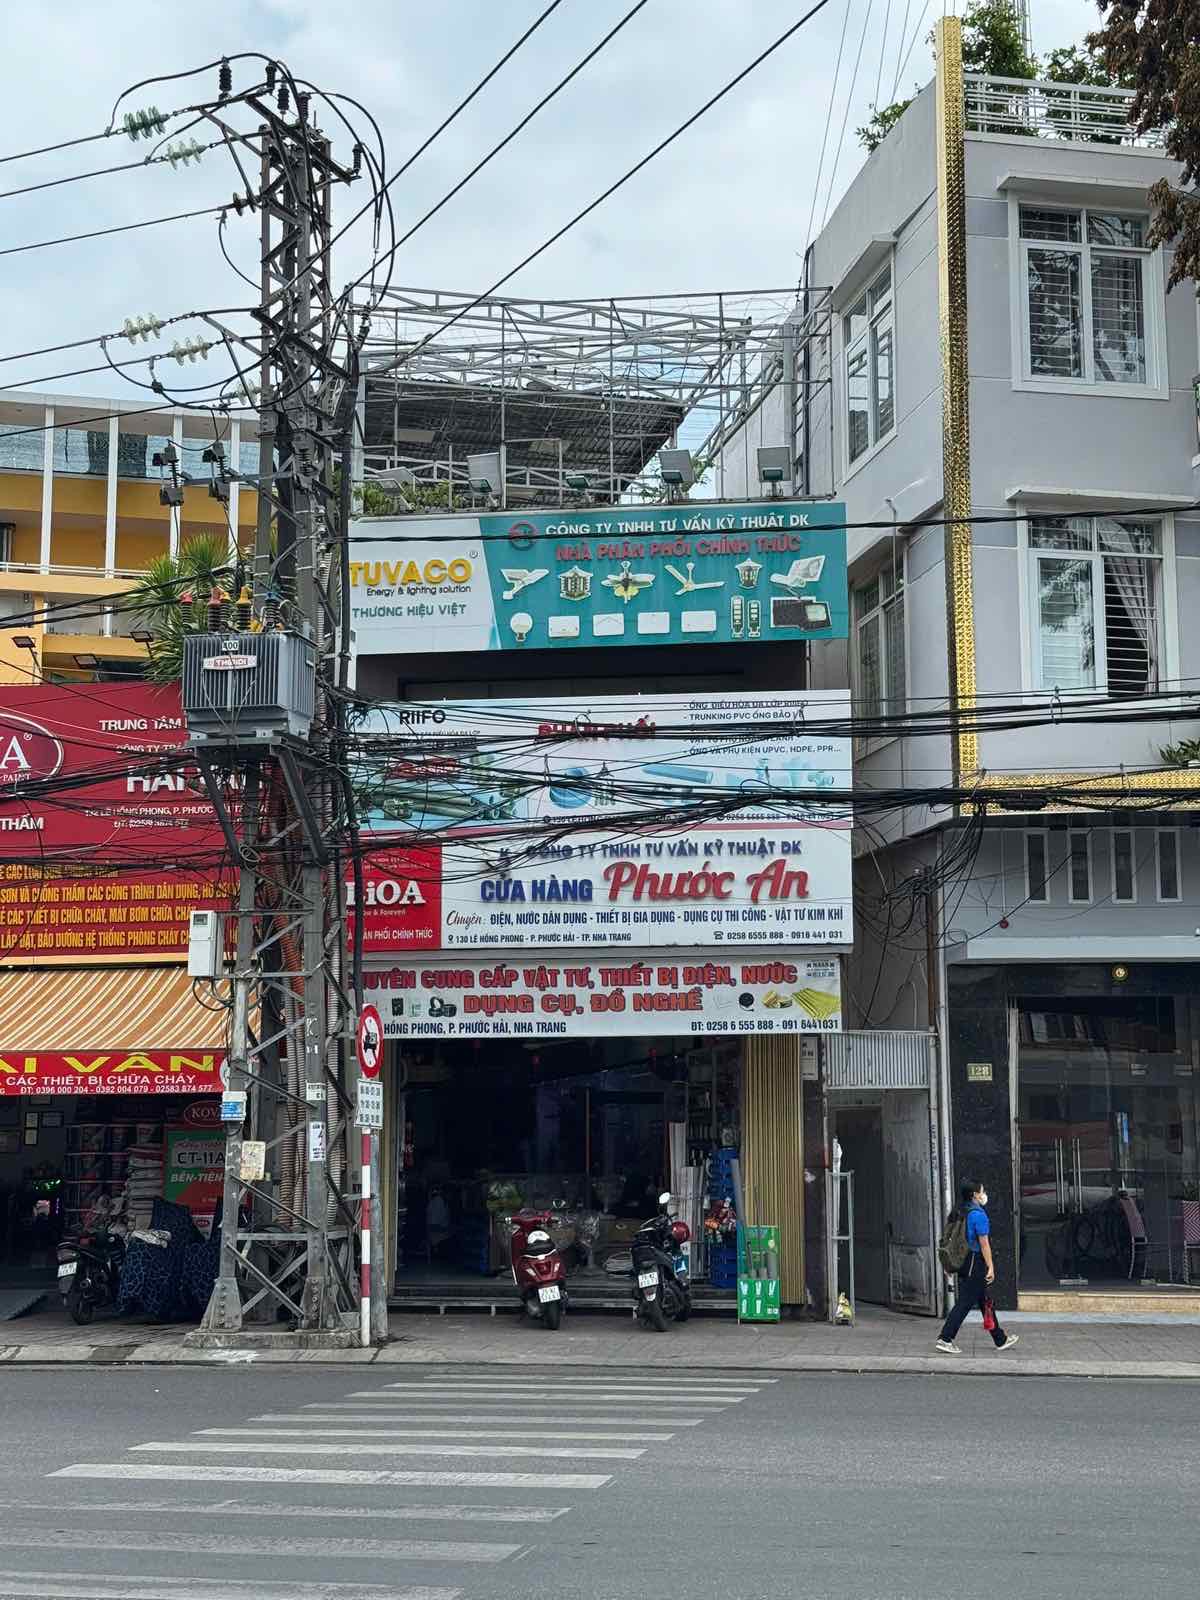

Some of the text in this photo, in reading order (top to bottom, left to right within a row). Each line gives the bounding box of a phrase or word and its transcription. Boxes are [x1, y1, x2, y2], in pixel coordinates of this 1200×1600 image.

[545, 521, 590, 535] CÔNG
[596, 520, 611, 534] TY
[617, 521, 654, 533] TNHH
[660, 518, 677, 531] TƯ
[682, 513, 711, 531] VẤN
[717, 514, 735, 529] KỸ
[741, 512, 785, 529] THUẬT
[555, 533, 801, 560] NHÀ PHÂN PHỐI CHÍNH THỨC
[349, 559, 472, 586] TUVACO
[367, 585, 471, 597] Energy & lighting solution
[352, 603, 466, 618] THƯƠNG HIỆU VIỆT
[99, 715, 182, 731] TRUNG TÂM
[690, 708, 791, 720] TRUNKING PVC ỐNG BẢO
[0, 735, 31, 769] A
[742, 745, 761, 755] KIỆN
[140, 804, 213, 816] PHONG, P. PHƯỚC
[1, 814, 44, 831] THẤM
[578, 845, 597, 858] TY
[601, 843, 640, 858] TNHH
[645, 841, 662, 857] TƯ
[668, 838, 698, 857] VẤN
[704, 839, 723, 856] KỸ
[728, 838, 775, 859] THUẬT
[531, 874, 593, 902] HÀNG
[603, 860, 735, 901] Phước
[746, 859, 809, 903] An
[0, 881, 171, 902] SƠN VÀ CHỐNG THẤM CÁC CÔNG TRÌNH DÂN
[7, 903, 173, 926] CÁC THIẾT BỊ CHỮA CHÁY, MÁY BƠM CHỮA
[490, 907, 843, 927] ĐIỆN, NƯỚC DÂN DỤNG THIẾT BỊ GIA DỤNG DỤNG CỤ THI CÔNG VẬT TƯ KIM KHÍ
[38, 929, 54, 948] BẢO
[56, 928, 84, 948] DƯỠNG
[86, 929, 96, 949] HỆ
[99, 926, 125, 948] THỐNG
[128, 928, 156, 946] PHÒNG
[374, 926, 434, 940] PHỐI CHÍNH THỨC
[456, 935, 468, 943] 130
[470, 934, 478, 943] LÊ
[480, 933, 498, 943] HỒNG
[500, 934, 524, 943] PHONG
[530, 934, 537, 942] P.
[538, 932, 562, 942] PHƯỚC
[563, 932, 575, 942] HẢI
[592, 933, 607, 941] NHA
[609, 932, 631, 941] TRANG
[727, 931, 746, 940] 0258
[769, 931, 784, 939] 888
[812, 930, 826, 938] 441
[829, 930, 843, 938] 031
[421, 970, 474, 989] CUNG
[479, 964, 519, 989] CẤP
[523, 966, 560, 991] VẬT
[564, 967, 594, 989] TƯ,
[599, 962, 653, 986] THIẾT
[658, 967, 678, 989] BỊ
[682, 963, 736, 989] ĐIỆN,
[741, 962, 798, 984] NƯỚC
[463, 987, 703, 1017] DỤNG CỤ, ĐỒ NGHỀ
[384, 1018, 566, 1036] HỒNG PHONG, P. PHƯỚC HẢI, NHA TRANG
[691, 1020, 704, 1031] ĐT:
[707, 1020, 728, 1031] 0258
[731, 1020, 736, 1030] 6
[738, 1020, 755, 1030] 555
[757, 1019, 773, 1030] 888
[782, 1019, 798, 1030] 091
[62, 1051, 214, 1073] VÂN
[6, 1073, 196, 1087] CÁC THIẾT BỊ CHỮA CHÁY
[58, 1086, 72, 1094] 000
[96, 1085, 114, 1093] 0392
[117, 1085, 131, 1093] 004
[134, 1085, 148, 1093] 079
[199, 1084, 213, 1092] 577
